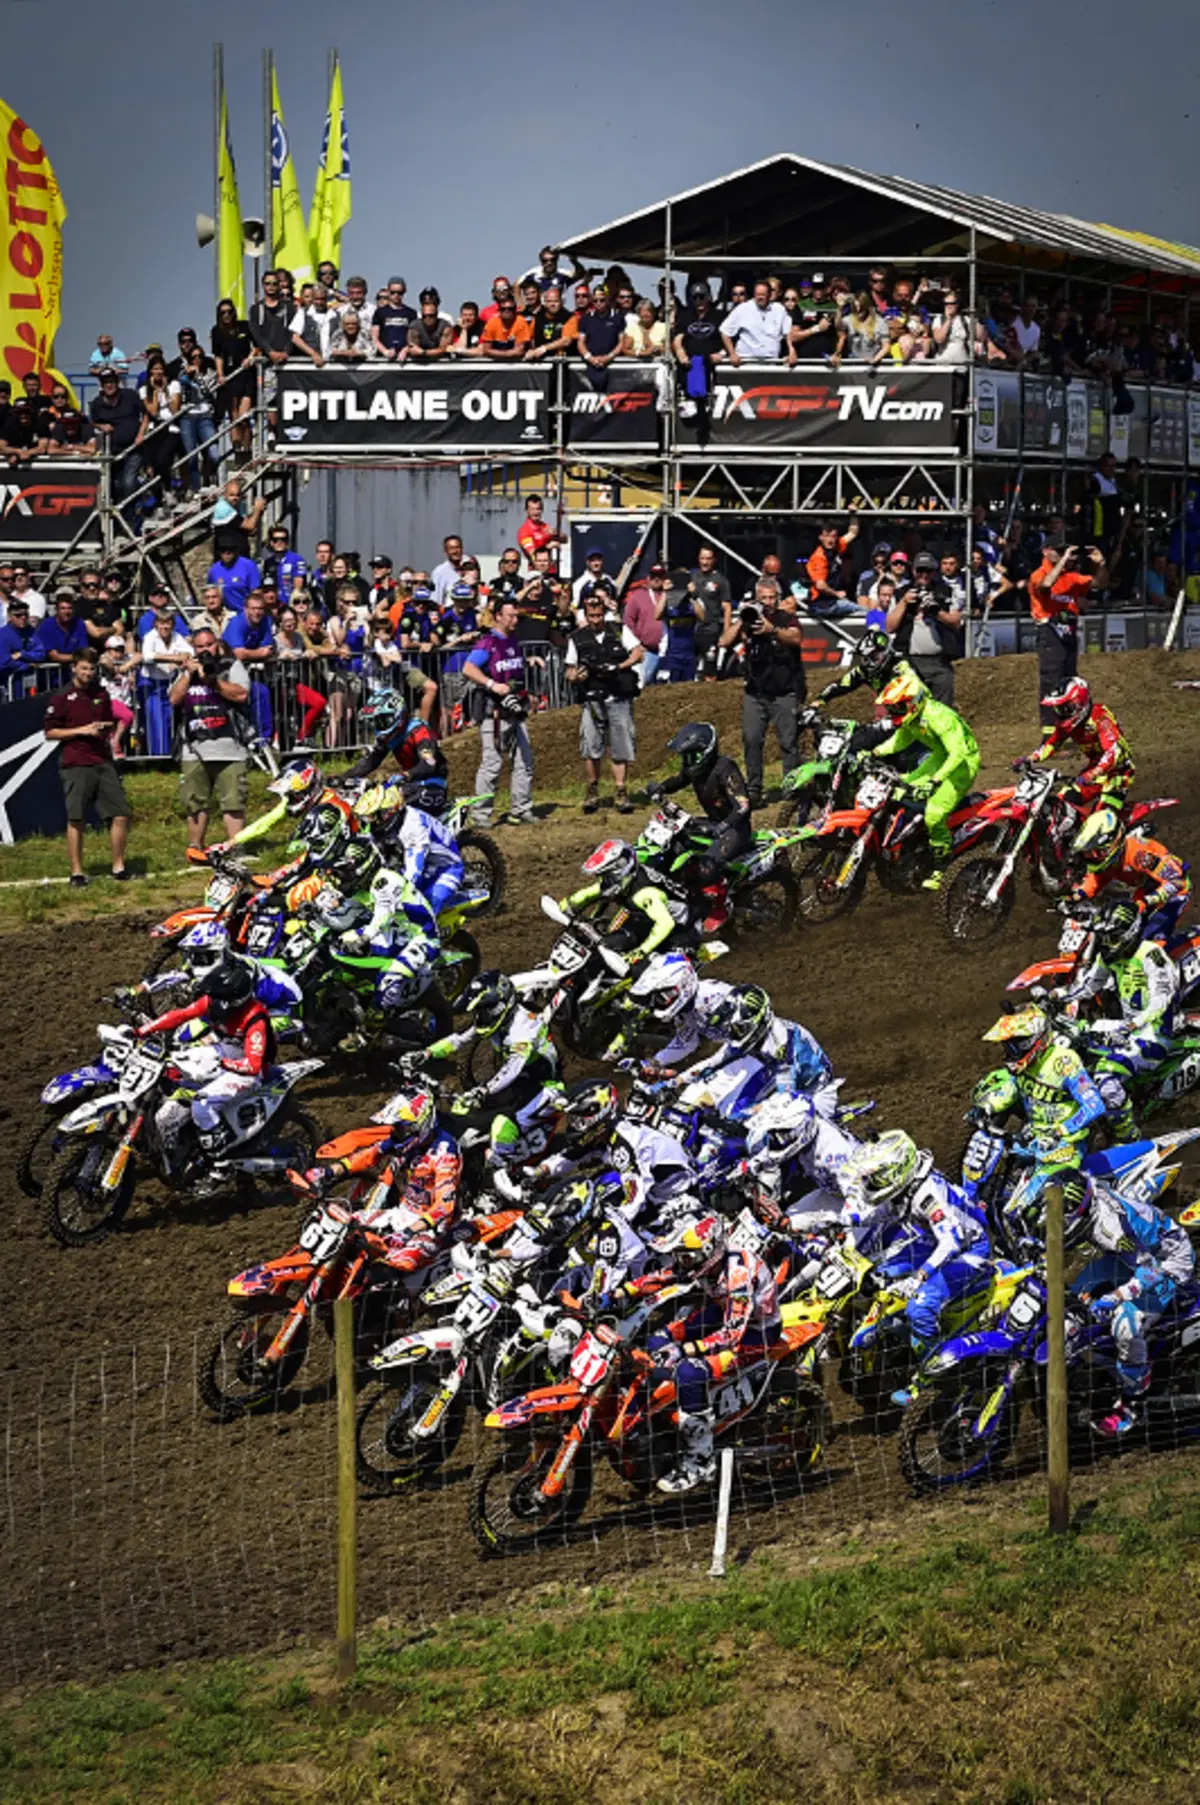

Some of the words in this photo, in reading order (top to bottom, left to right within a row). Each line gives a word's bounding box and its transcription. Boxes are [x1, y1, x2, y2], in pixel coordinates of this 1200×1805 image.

[6, 117, 48, 309] LOTTO
[282, 390, 448, 420] PITLANE
[461, 389, 545, 421] OUT
[573, 392, 653, 413] MXGP
[0, 484, 97, 520] XGP
[299, 1220, 341, 1260] 61
[815, 1264, 851, 1299] 91
[570, 1348, 607, 1387] 41
[719, 1376, 754, 1416] 41
